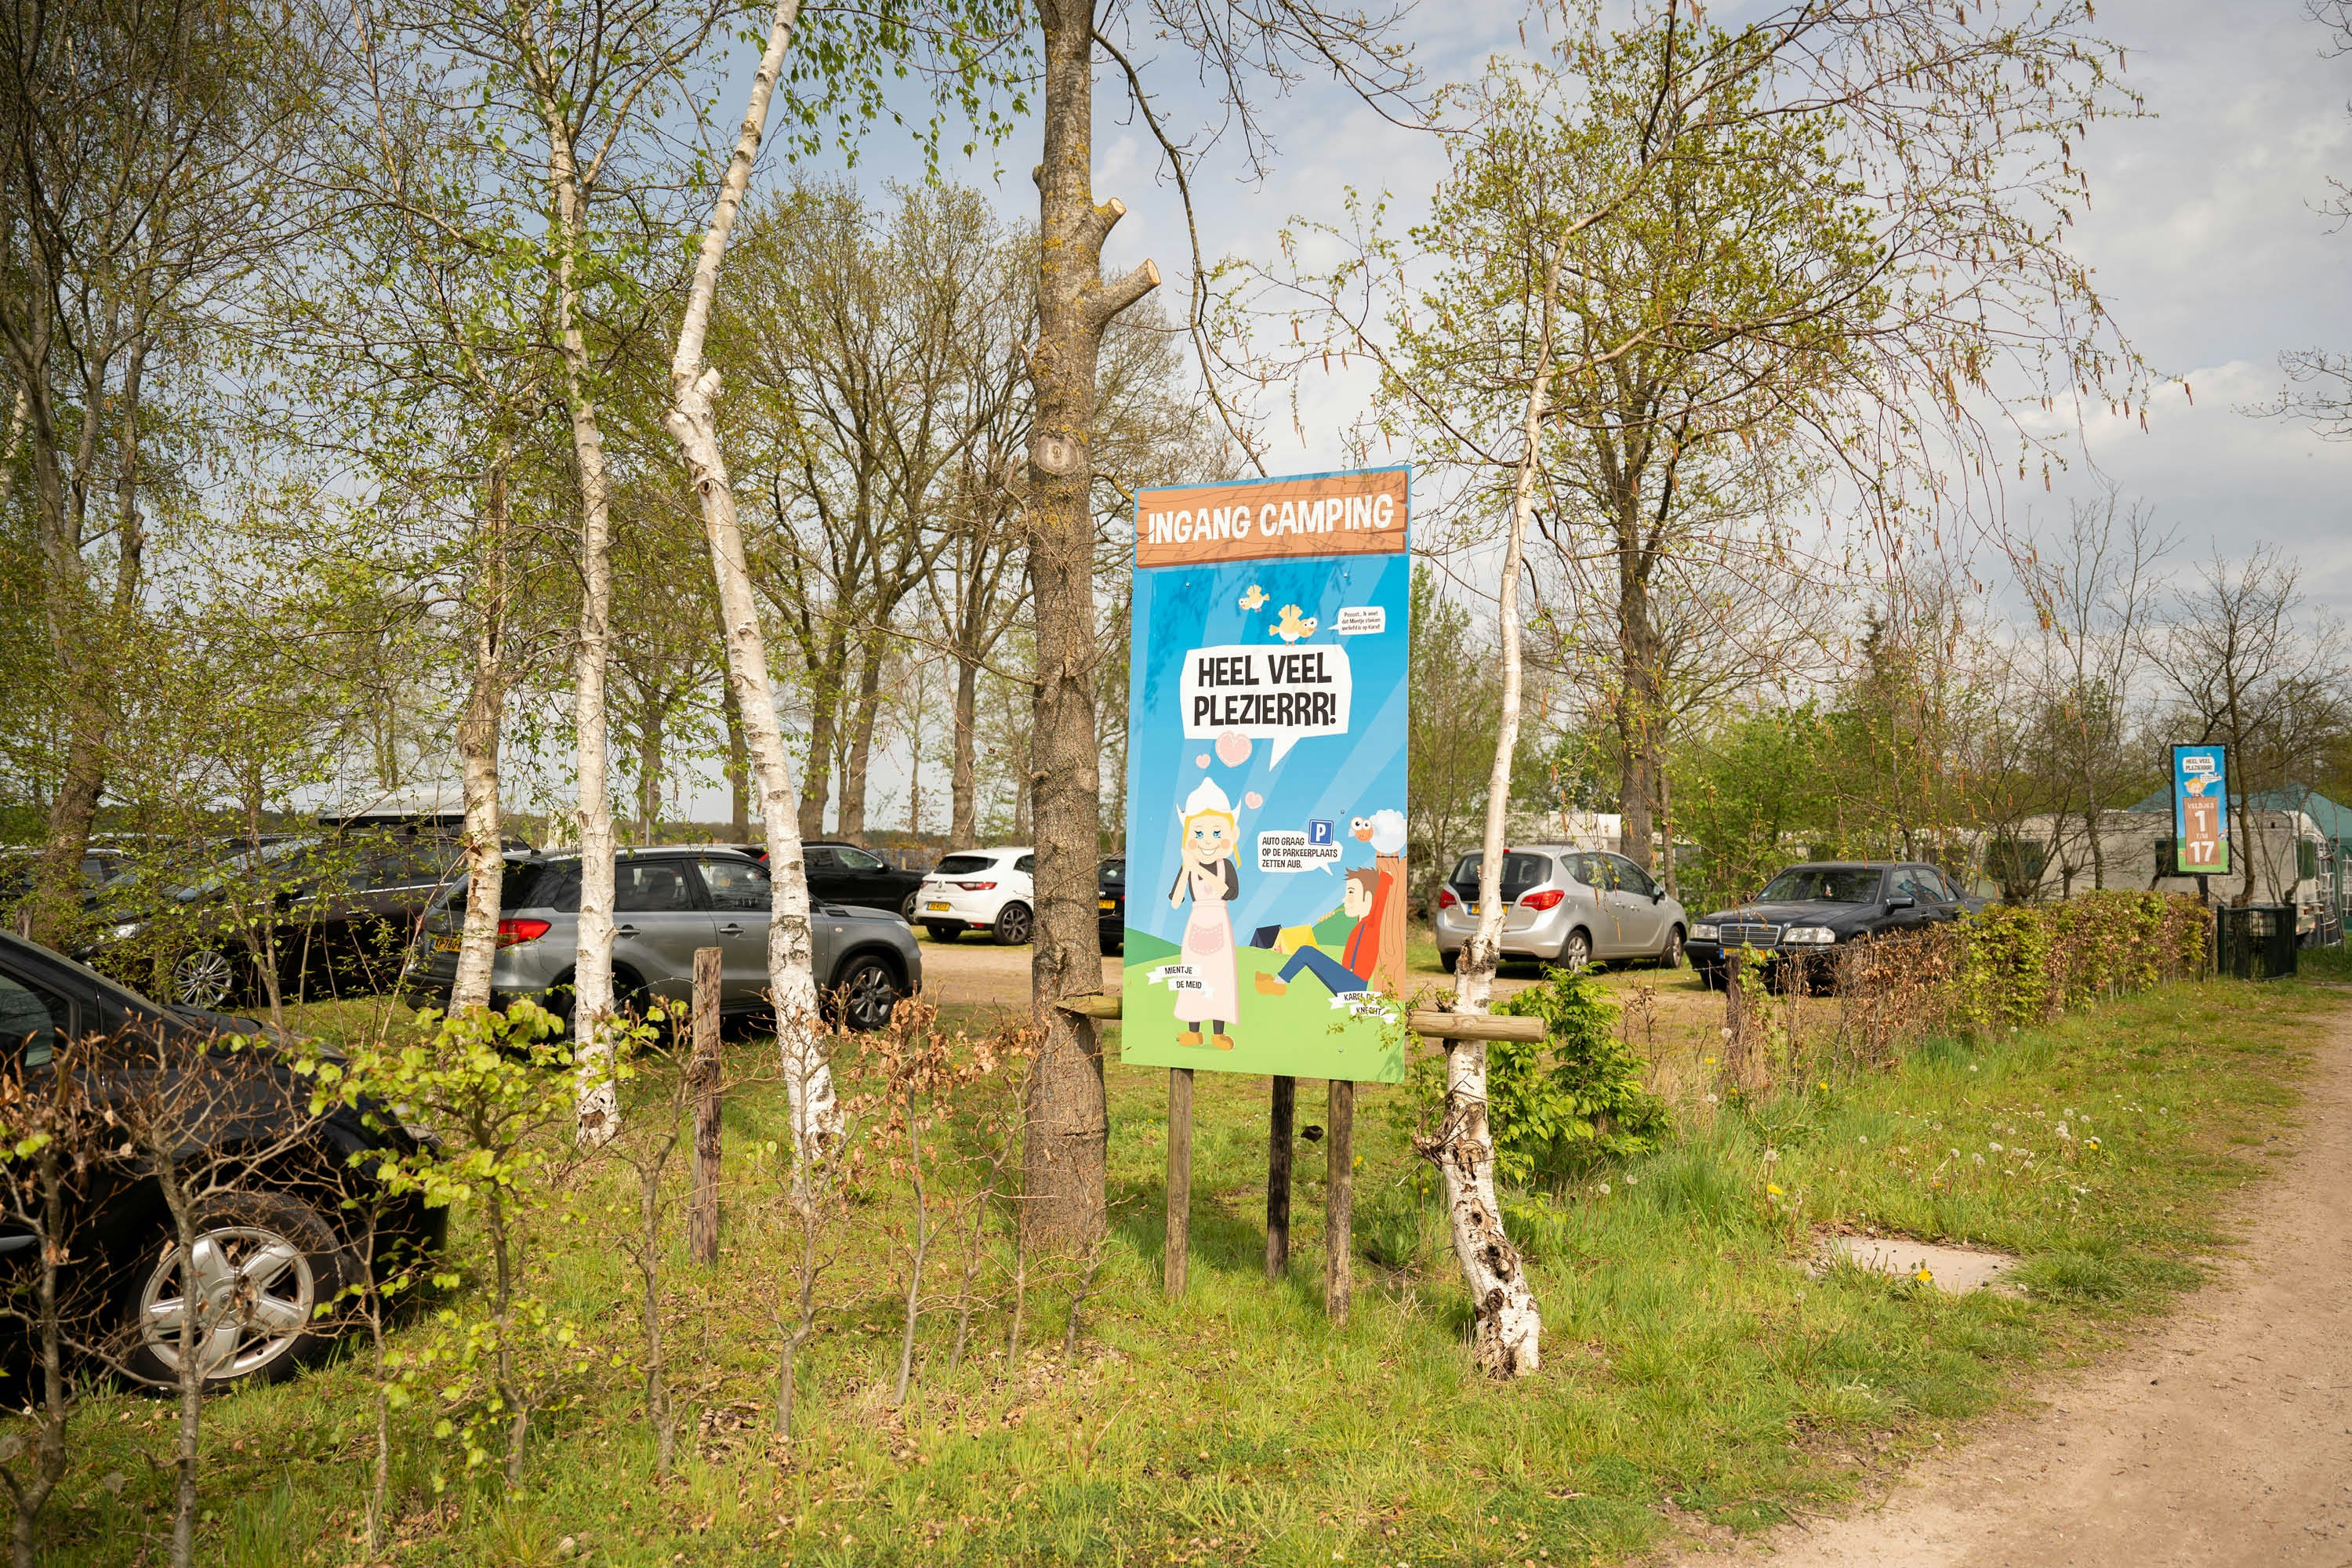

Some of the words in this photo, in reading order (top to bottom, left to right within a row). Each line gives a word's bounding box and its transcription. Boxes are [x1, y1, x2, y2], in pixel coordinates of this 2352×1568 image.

[1148, 506, 1251, 544] INGANG
[1259, 493, 1394, 536] CAMPING
[1198, 655, 1259, 688] HEEL
[1268, 652, 1332, 686] VEEL
[1193, 691, 1336, 727] PLEZIERRR!
[2194, 810, 2205, 832] 1
[1262, 837, 1280, 846] AUTO
[1281, 837, 1305, 846] GRAAG
[1316, 823, 1327, 842] P
[1261, 848, 1271, 857] OP
[1272, 848, 1281, 857] DE
[1283, 848, 1338, 858] PARKEERPLAATS
[2189, 840, 2215, 862] 17
[1262, 859, 1286, 868] ZETTEN
[1287, 859, 1303, 869] AUB.
[1164, 966, 1193, 975] MIENTJE
[1185, 980, 1202, 989] MEID
